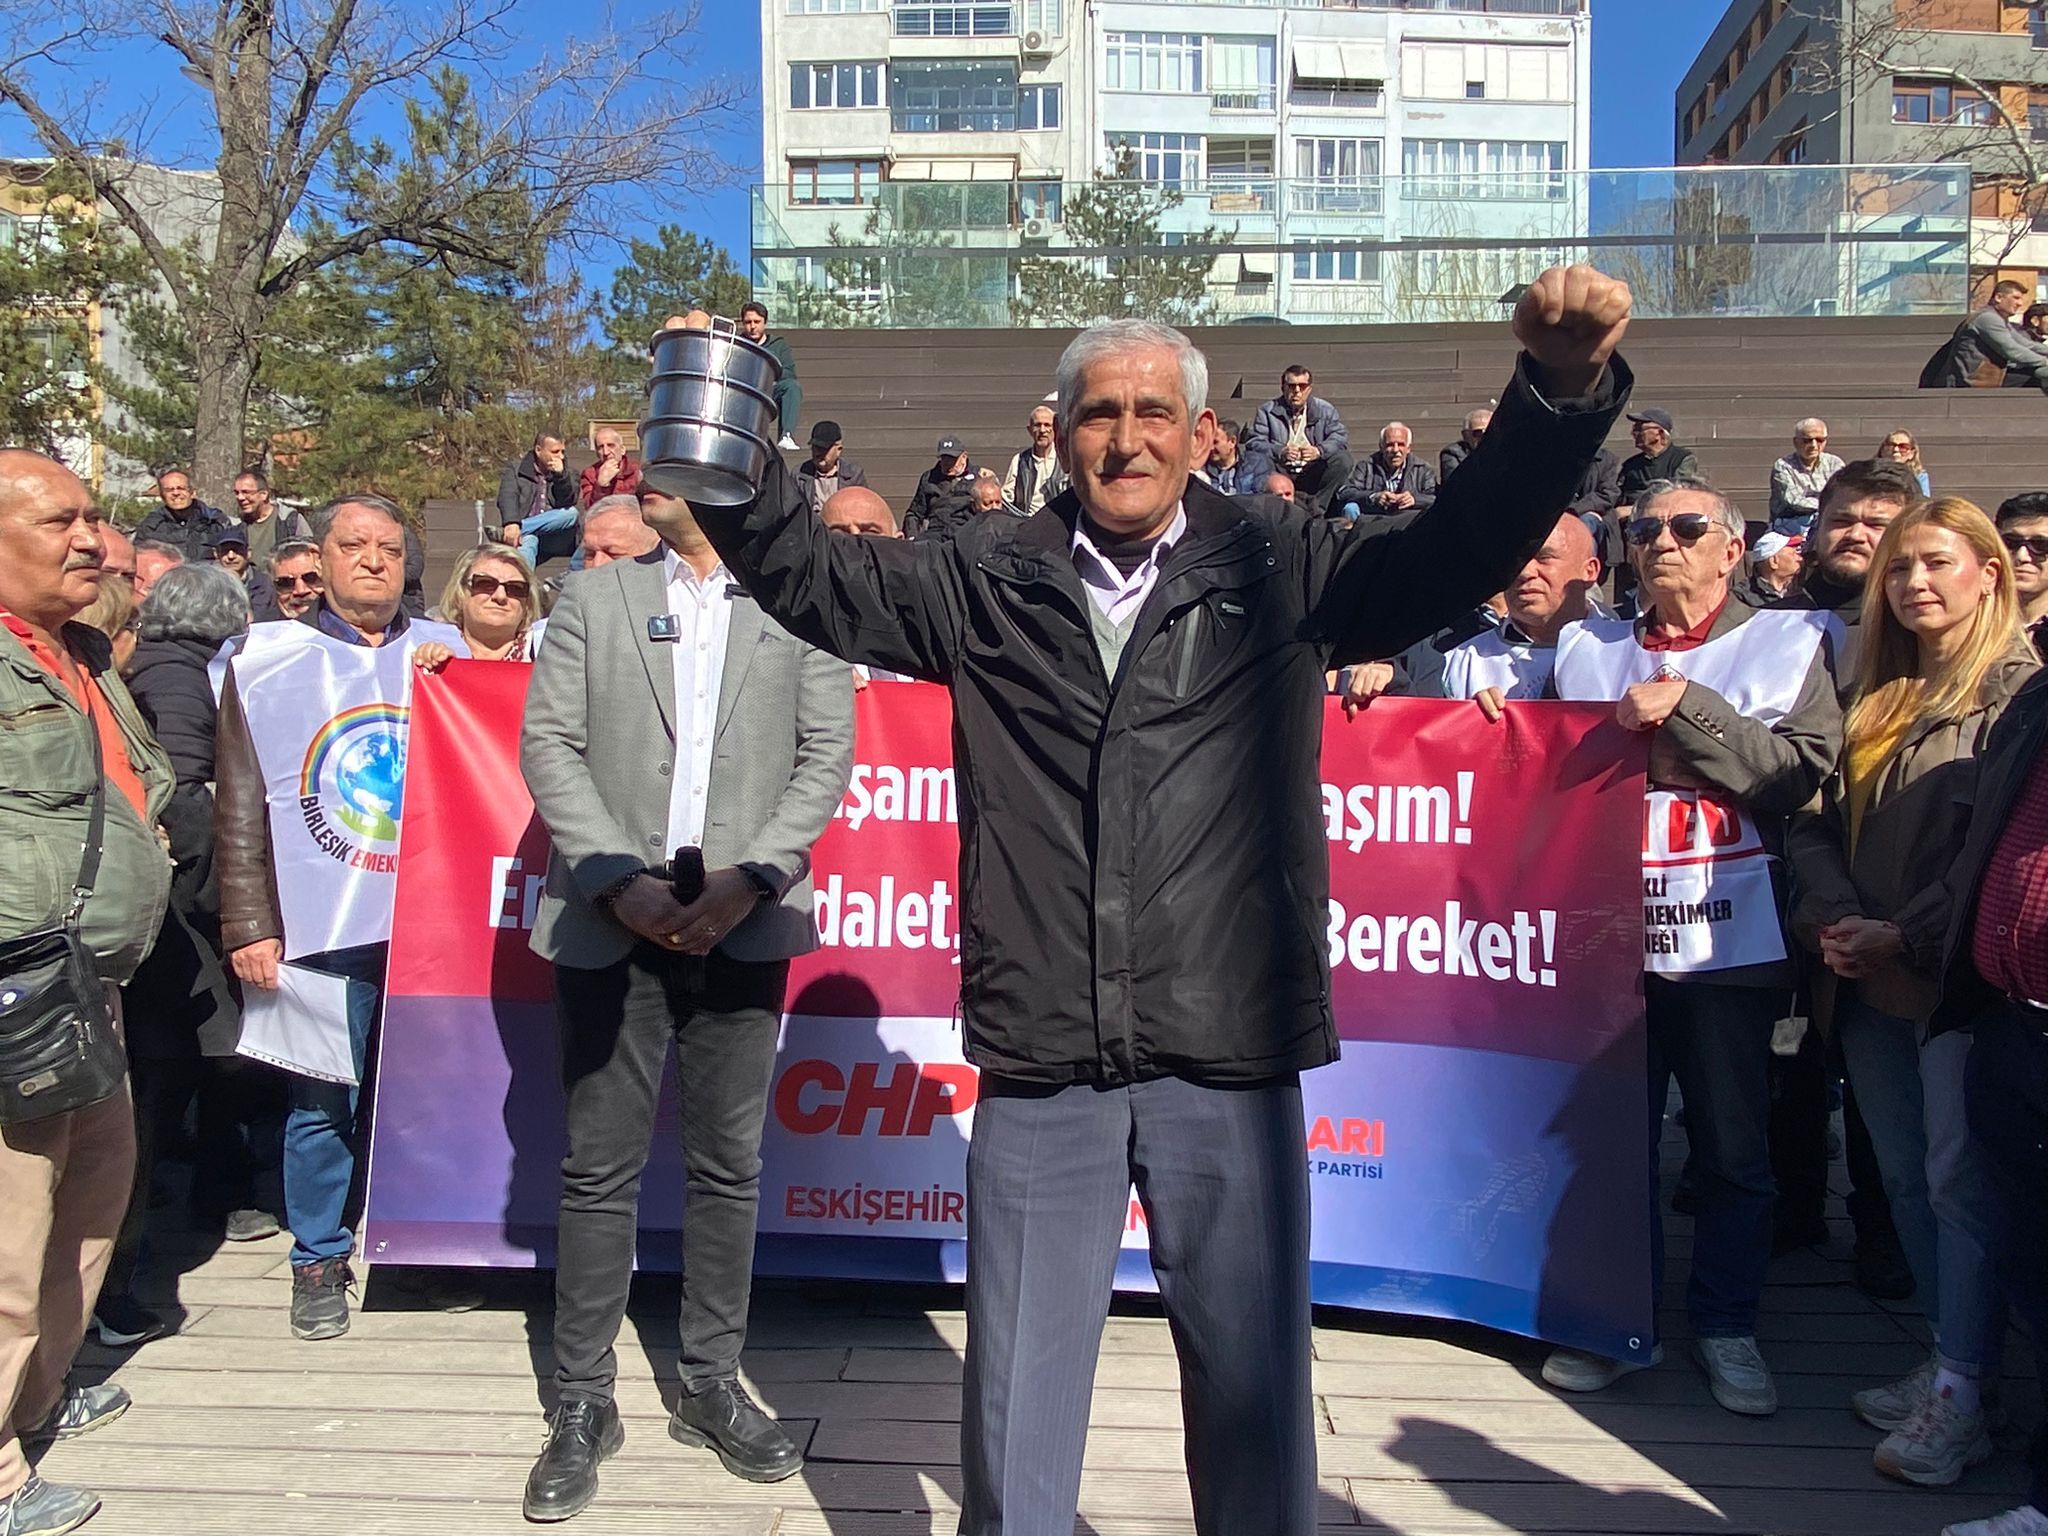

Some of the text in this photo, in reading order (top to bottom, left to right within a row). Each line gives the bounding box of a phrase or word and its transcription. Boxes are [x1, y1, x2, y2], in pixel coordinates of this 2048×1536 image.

[300, 795, 354, 862] BİRLEŞİK
[834, 764, 958, 831] şam
[1327, 899, 1557, 987] Bereket!
[774, 1058, 1385, 1157] CHP ARI
[785, 1182, 965, 1225] ESKİŞEHİR
[1317, 1161, 1383, 1179] PARTİSİ
